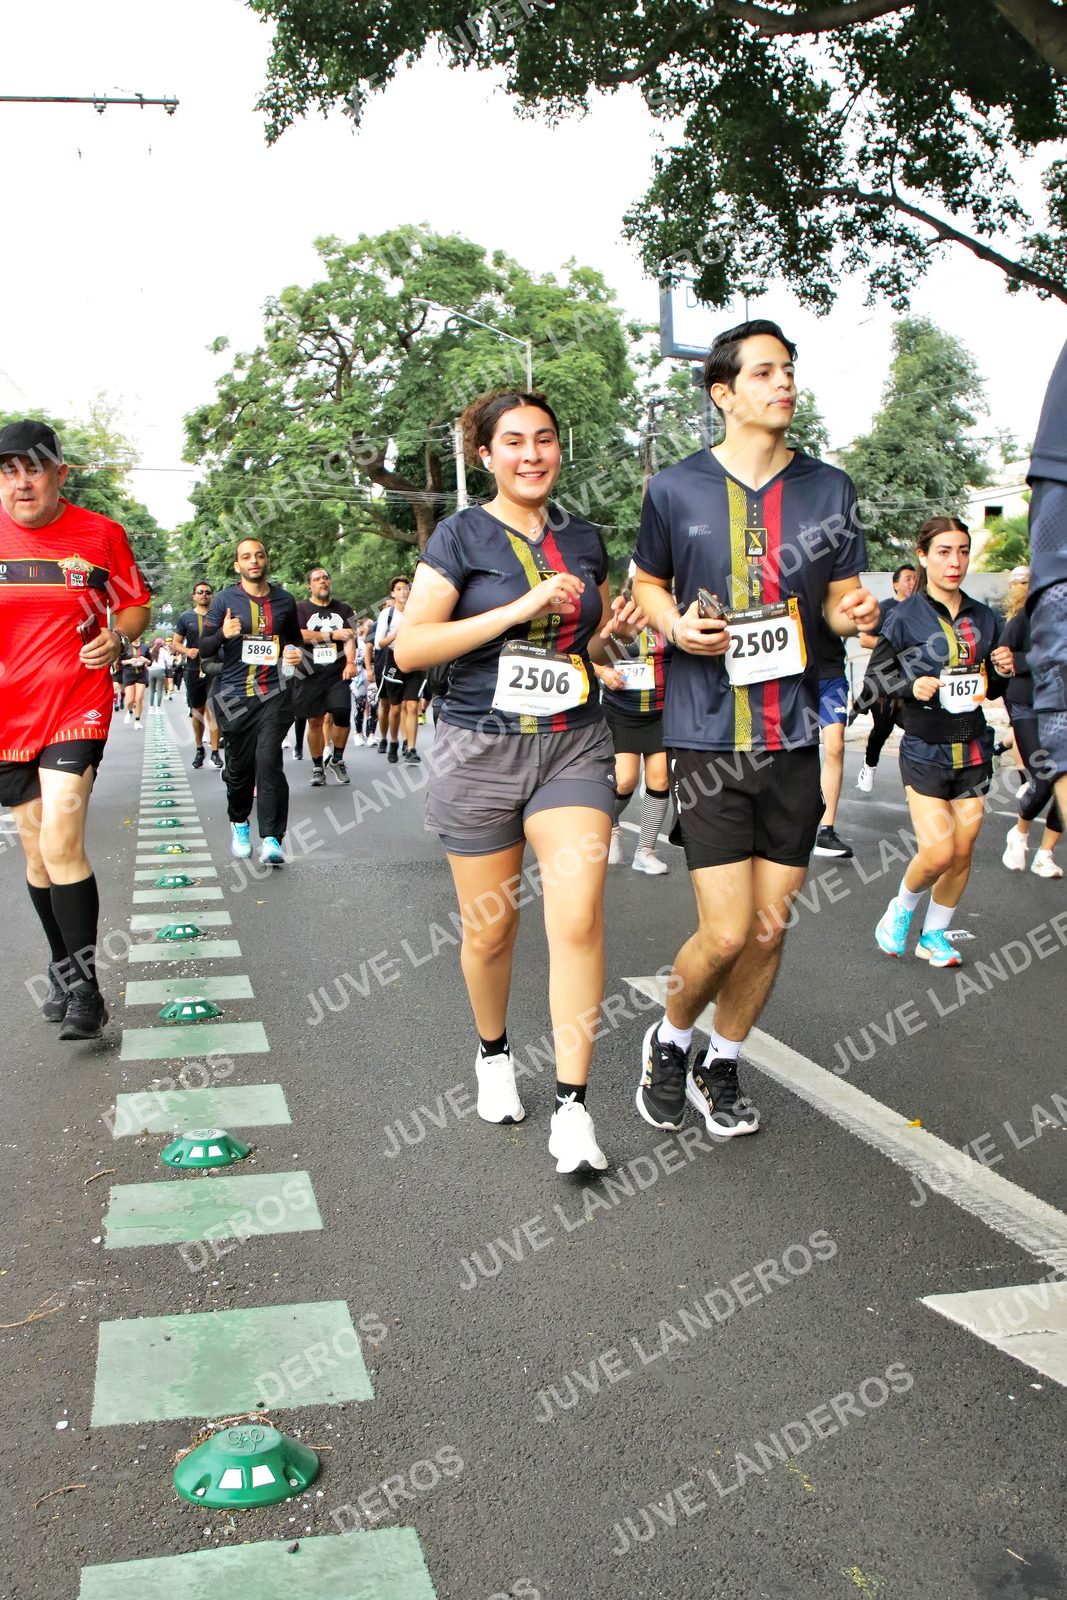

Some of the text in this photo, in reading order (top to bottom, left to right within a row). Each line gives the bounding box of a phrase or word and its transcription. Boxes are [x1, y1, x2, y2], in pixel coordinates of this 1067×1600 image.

[731, 626, 788, 658] 2509
[248, 644, 272, 654] 5896
[317, 650, 332, 658] 2615
[621, 667, 645, 678] 797
[509, 665, 570, 695] 2506
[949, 680, 978, 696] 1657
